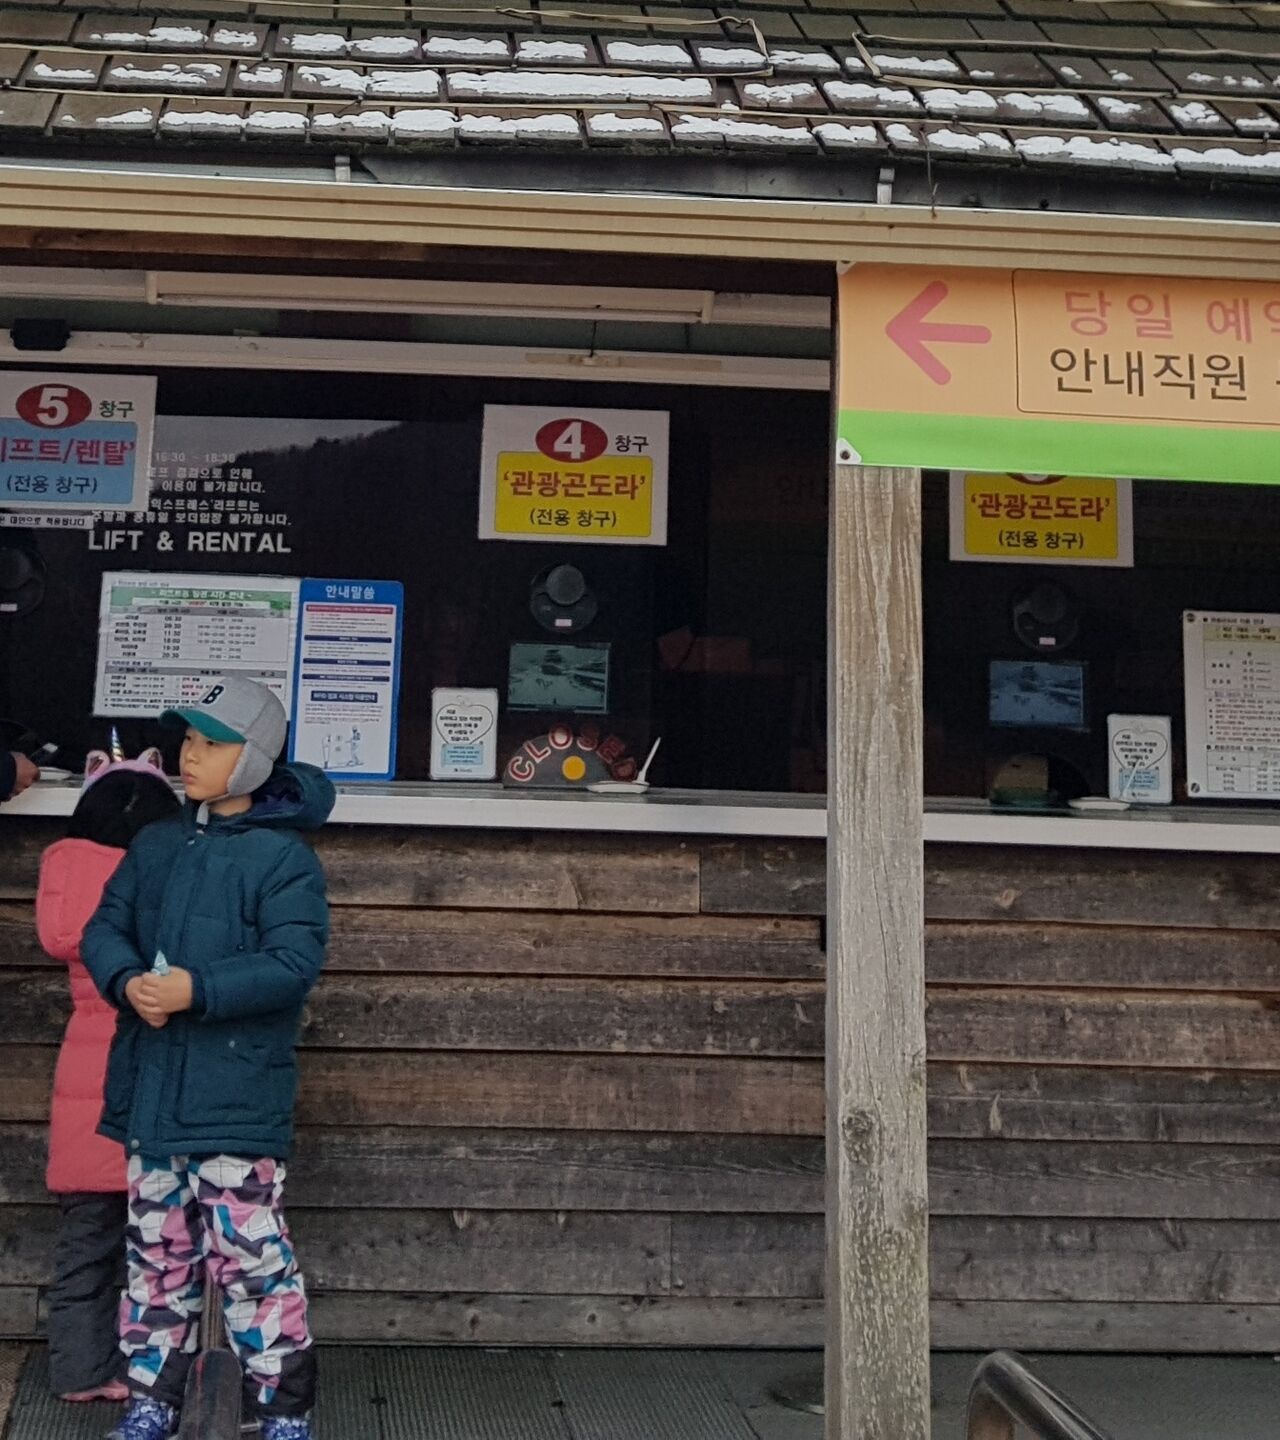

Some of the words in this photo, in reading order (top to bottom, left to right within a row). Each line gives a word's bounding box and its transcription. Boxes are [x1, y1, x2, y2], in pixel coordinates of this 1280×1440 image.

[1064, 289, 1173, 339] 당일
[1050, 347, 1247, 401] 안내직원
[36, 387, 69, 426] 5
[99, 400, 135, 418] 창구
[553, 421, 585, 460] 4
[615, 435, 649, 453] 창구
[7, 475, 49, 494] (전용
[55, 476, 98, 494] 창구)
[162, 480, 197, 492] 이용이
[530, 508, 570, 526] (전용
[577, 510, 617, 527] 창구)
[88, 530, 143, 551] LIFT
[156, 530, 174, 551] &
[188, 531, 291, 553] RENTAL
[999, 530, 1038, 548] (전용
[1045, 532, 1084, 550] 창구)
[325, 585, 375, 599] 안내말씀
[202, 685, 224, 704] B
[508, 723, 638, 781] CLOSED
